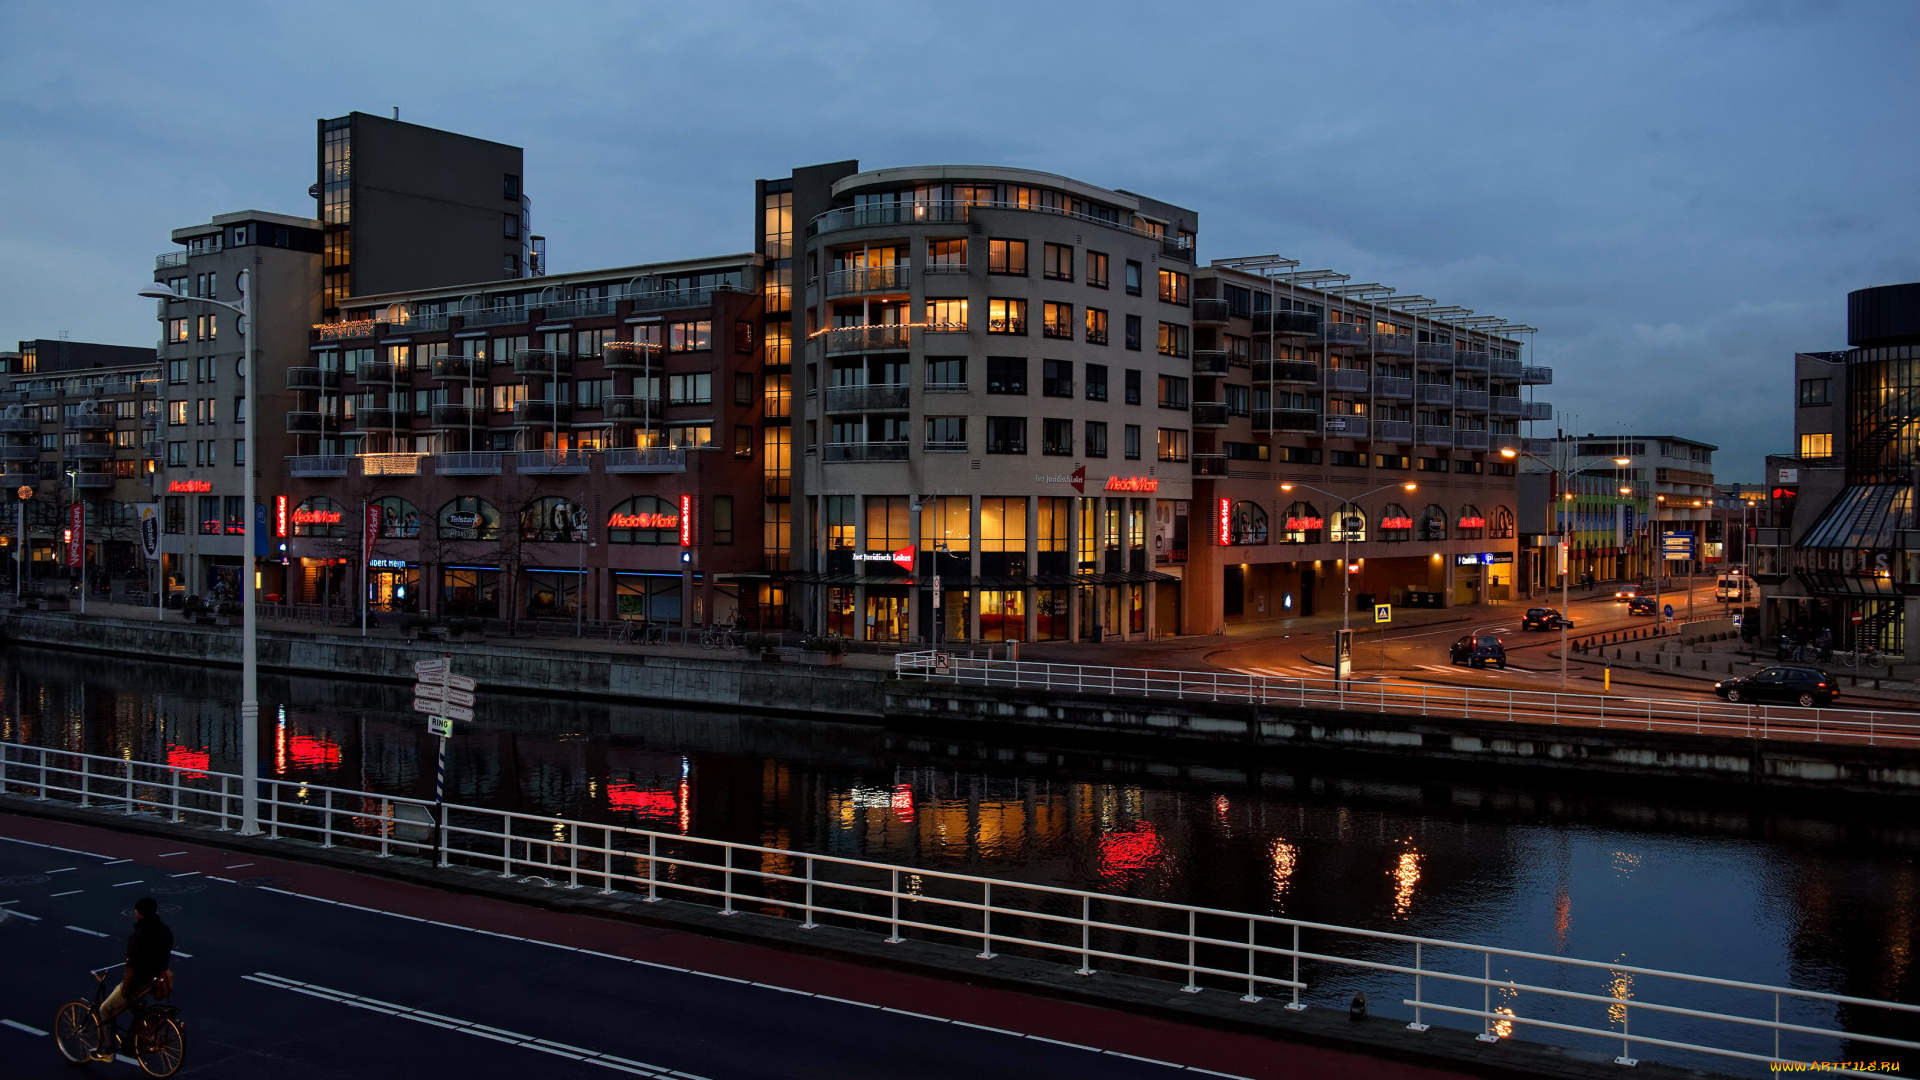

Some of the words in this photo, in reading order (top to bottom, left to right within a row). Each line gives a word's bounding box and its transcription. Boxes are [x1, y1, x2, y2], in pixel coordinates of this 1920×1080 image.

[863, 553, 891, 562] Juridisch
[892, 553, 912, 562] Loket
[369, 559, 388, 567] lbert
[432, 718, 448, 728] RING
